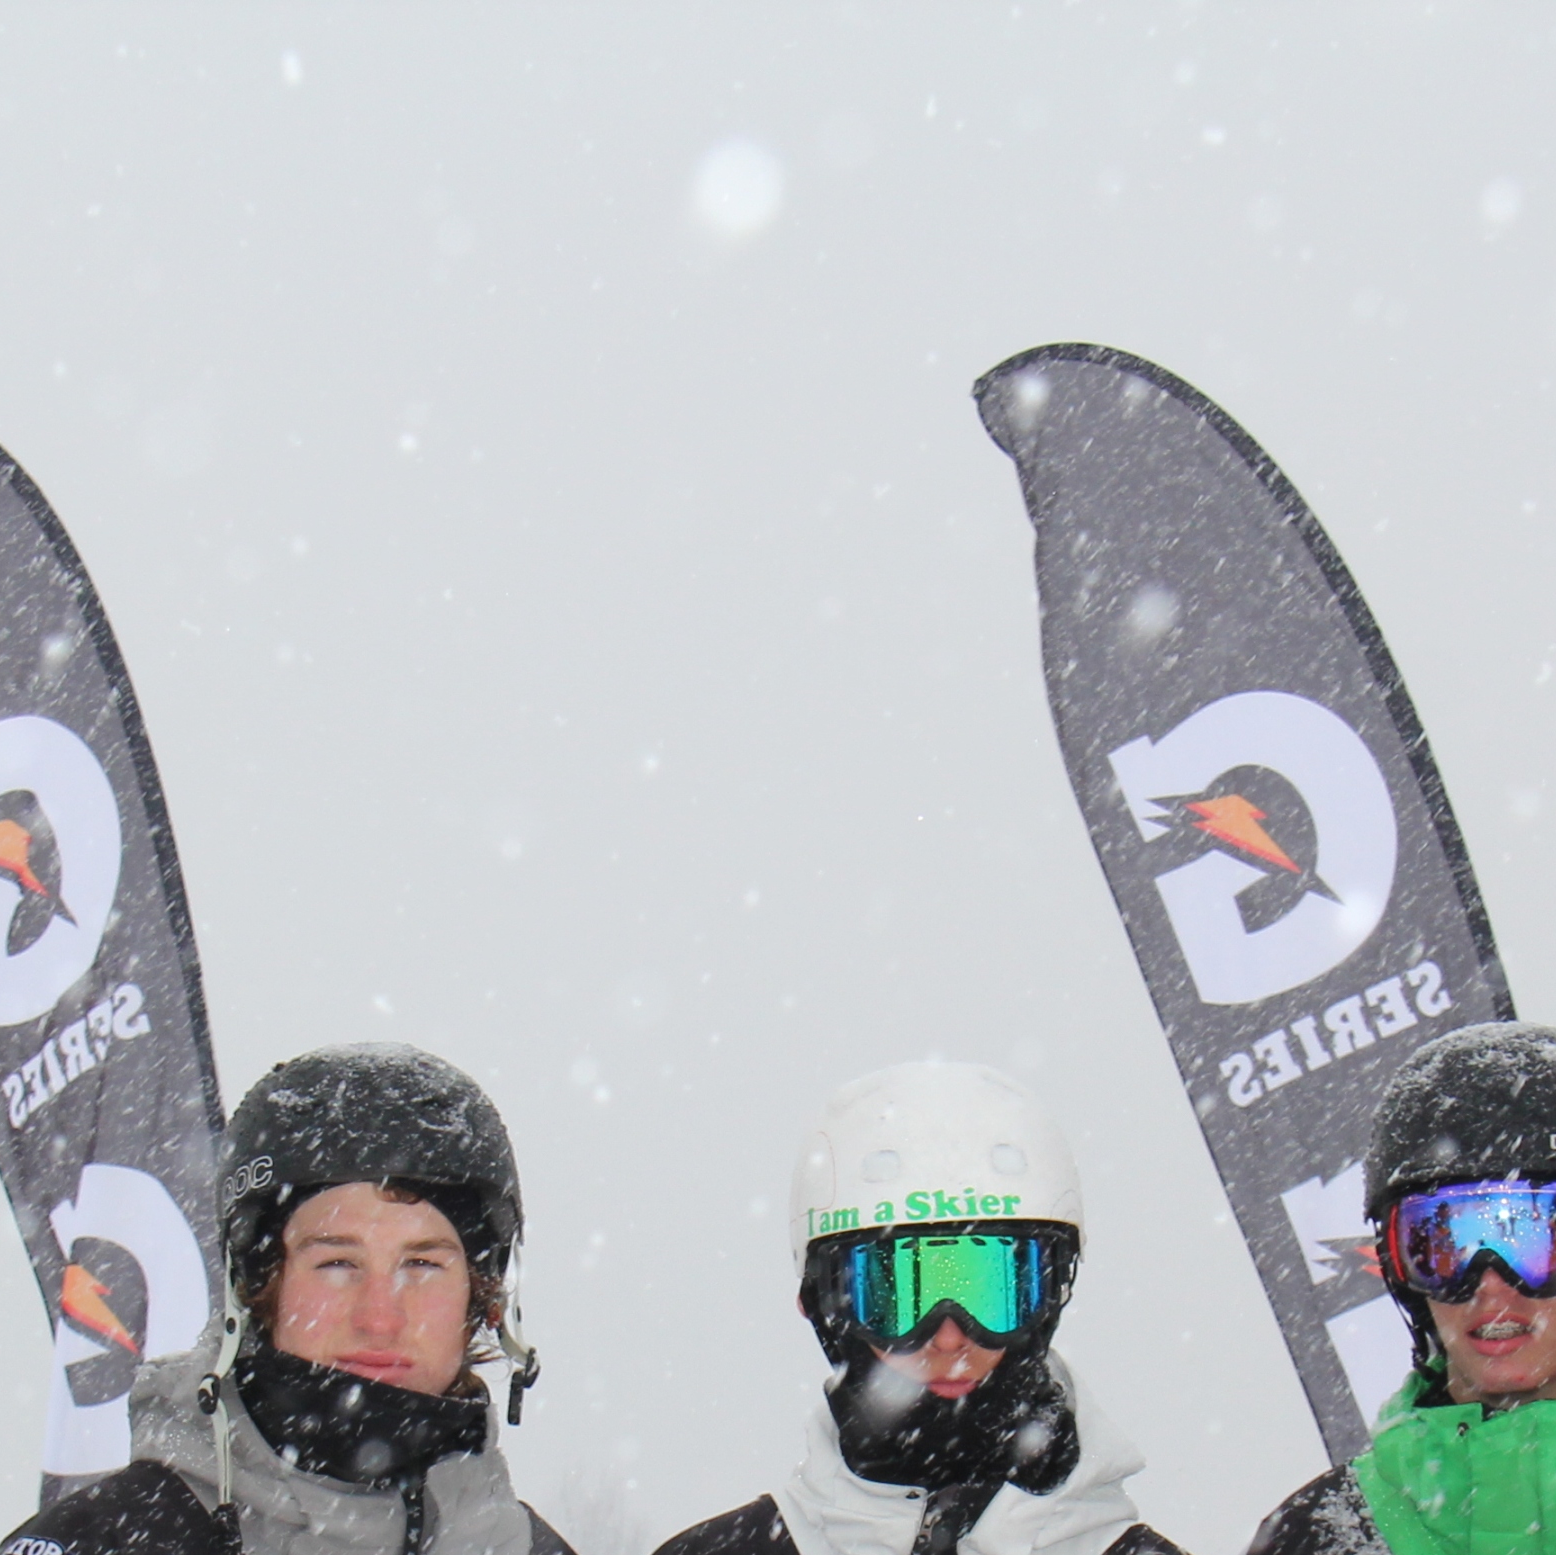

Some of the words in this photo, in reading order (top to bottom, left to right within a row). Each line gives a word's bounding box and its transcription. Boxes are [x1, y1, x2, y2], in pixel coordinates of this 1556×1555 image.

[819, 1205, 860, 1234] am
[874, 1200, 895, 1223] a
[904, 1187, 1022, 1221] Skier
